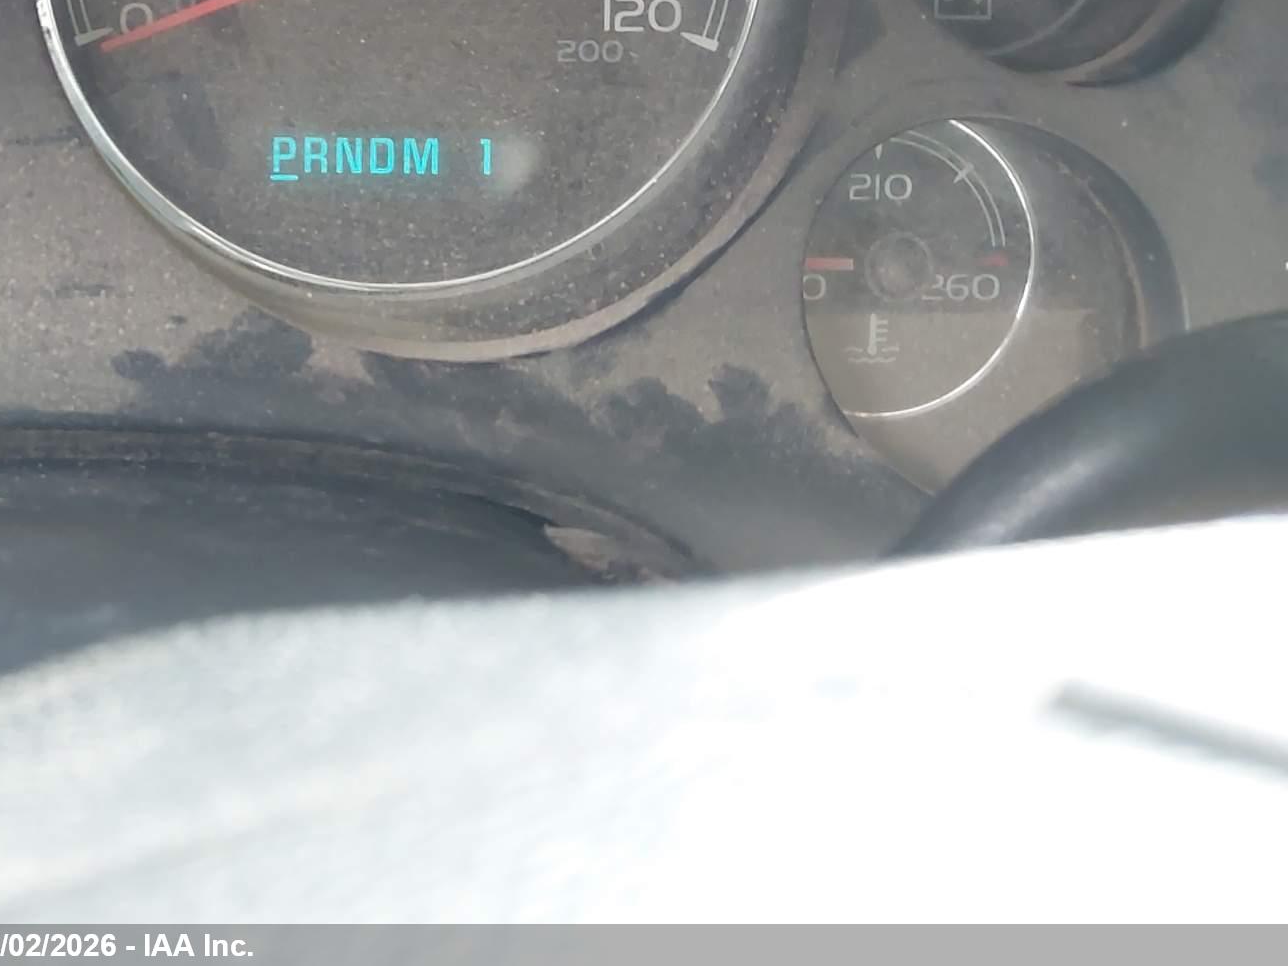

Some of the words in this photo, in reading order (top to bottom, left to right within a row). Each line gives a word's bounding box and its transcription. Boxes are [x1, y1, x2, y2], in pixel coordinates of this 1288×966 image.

[119, 2, 154, 36] 0
[557, 40, 624, 62] 200
[270, 136, 439, 177] PRNDM
[479, 138, 492, 176] 1
[848, 172, 913, 201] 210
[921, 273, 1001, 301] 260
